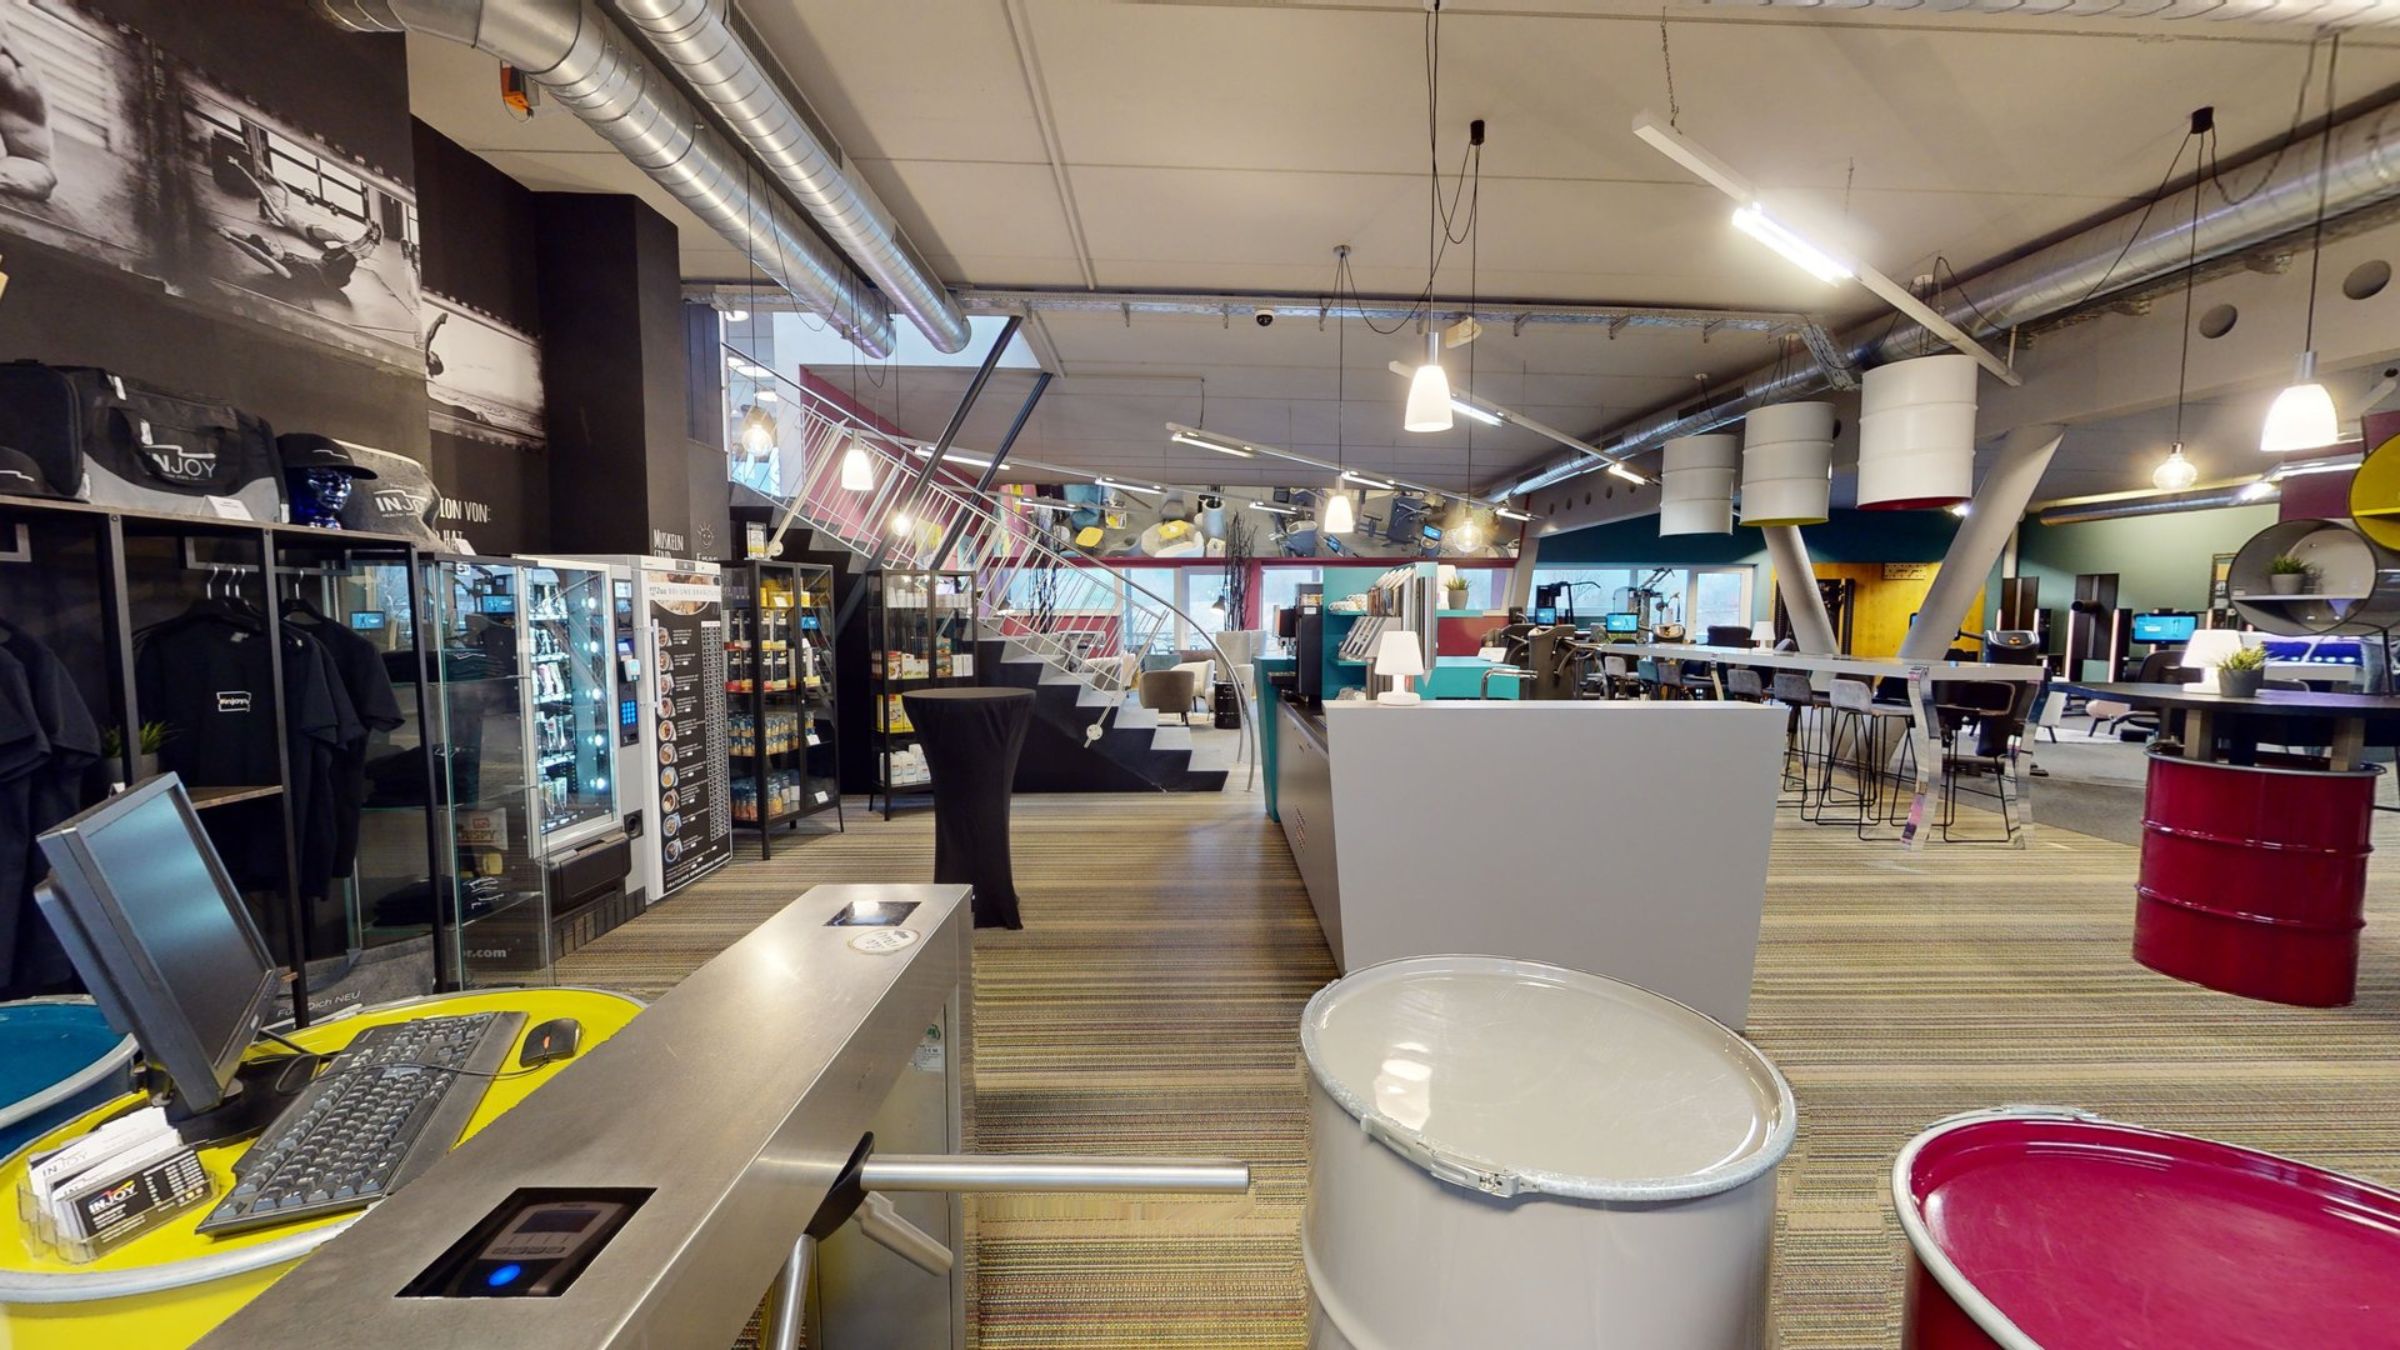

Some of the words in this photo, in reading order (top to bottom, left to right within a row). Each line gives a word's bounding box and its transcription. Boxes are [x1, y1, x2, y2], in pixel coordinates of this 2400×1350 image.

[147, 453, 216, 478] NJOY
[375, 497, 424, 514] INJO
[464, 501, 491, 523] VON:
[653, 528, 684, 551] MUSKELN
[463, 949, 507, 958] r.com
[335, 990, 361, 1003] NEU
[88, 1183, 136, 1216] INJOY
